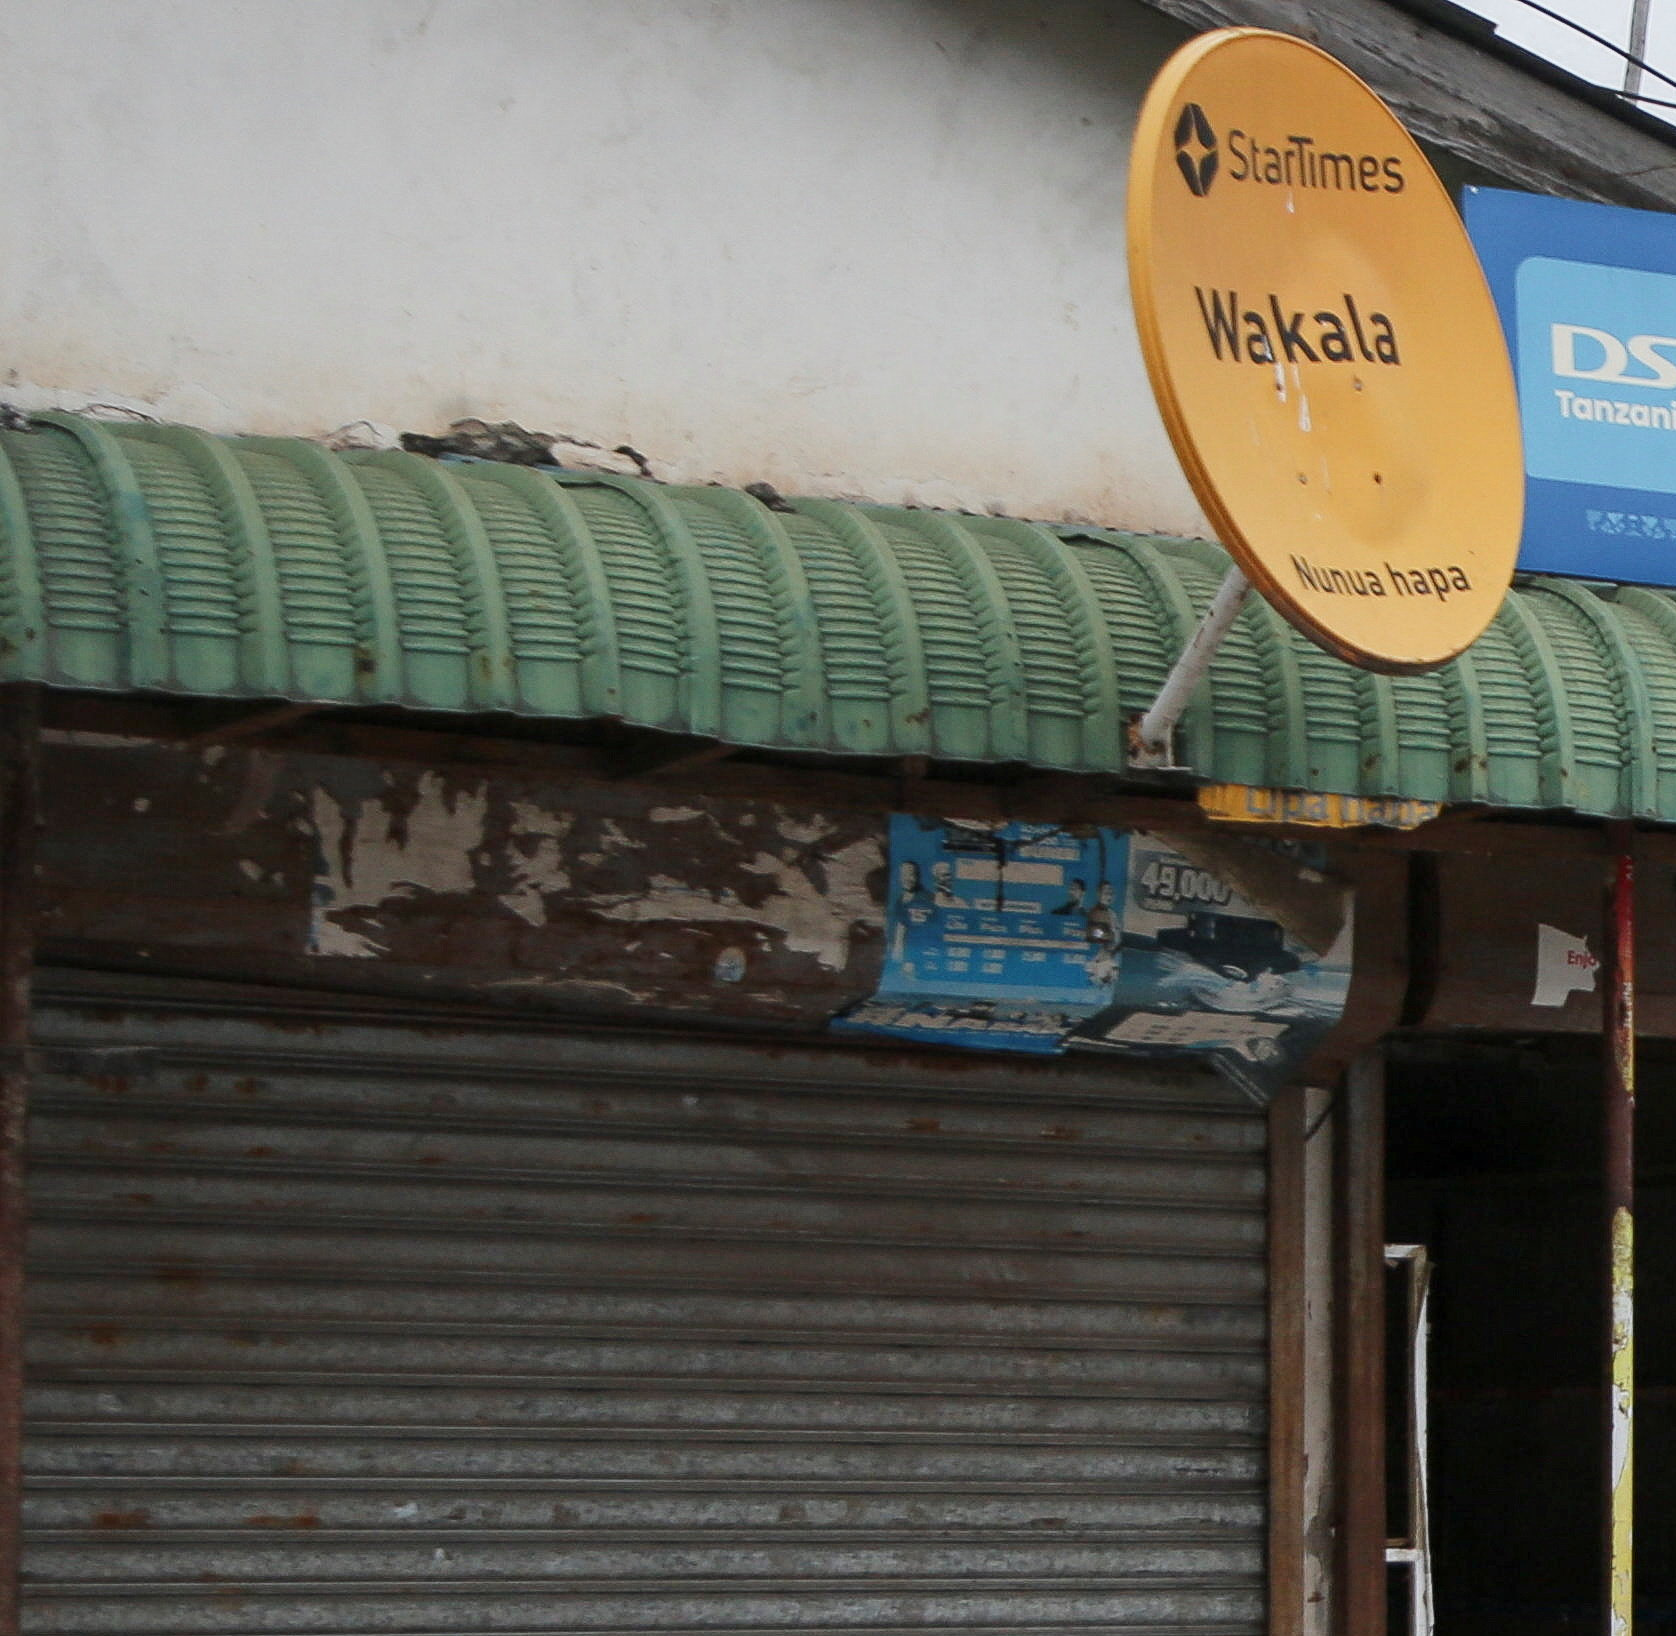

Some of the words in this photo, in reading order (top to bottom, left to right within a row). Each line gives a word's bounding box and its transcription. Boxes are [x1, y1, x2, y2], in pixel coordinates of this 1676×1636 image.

[1228, 130, 1404, 194] StarTimes
[1195, 287, 1399, 366] Wakala
[1291, 553, 1381, 597] Nunua
[1391, 559, 1471, 606] hapa
